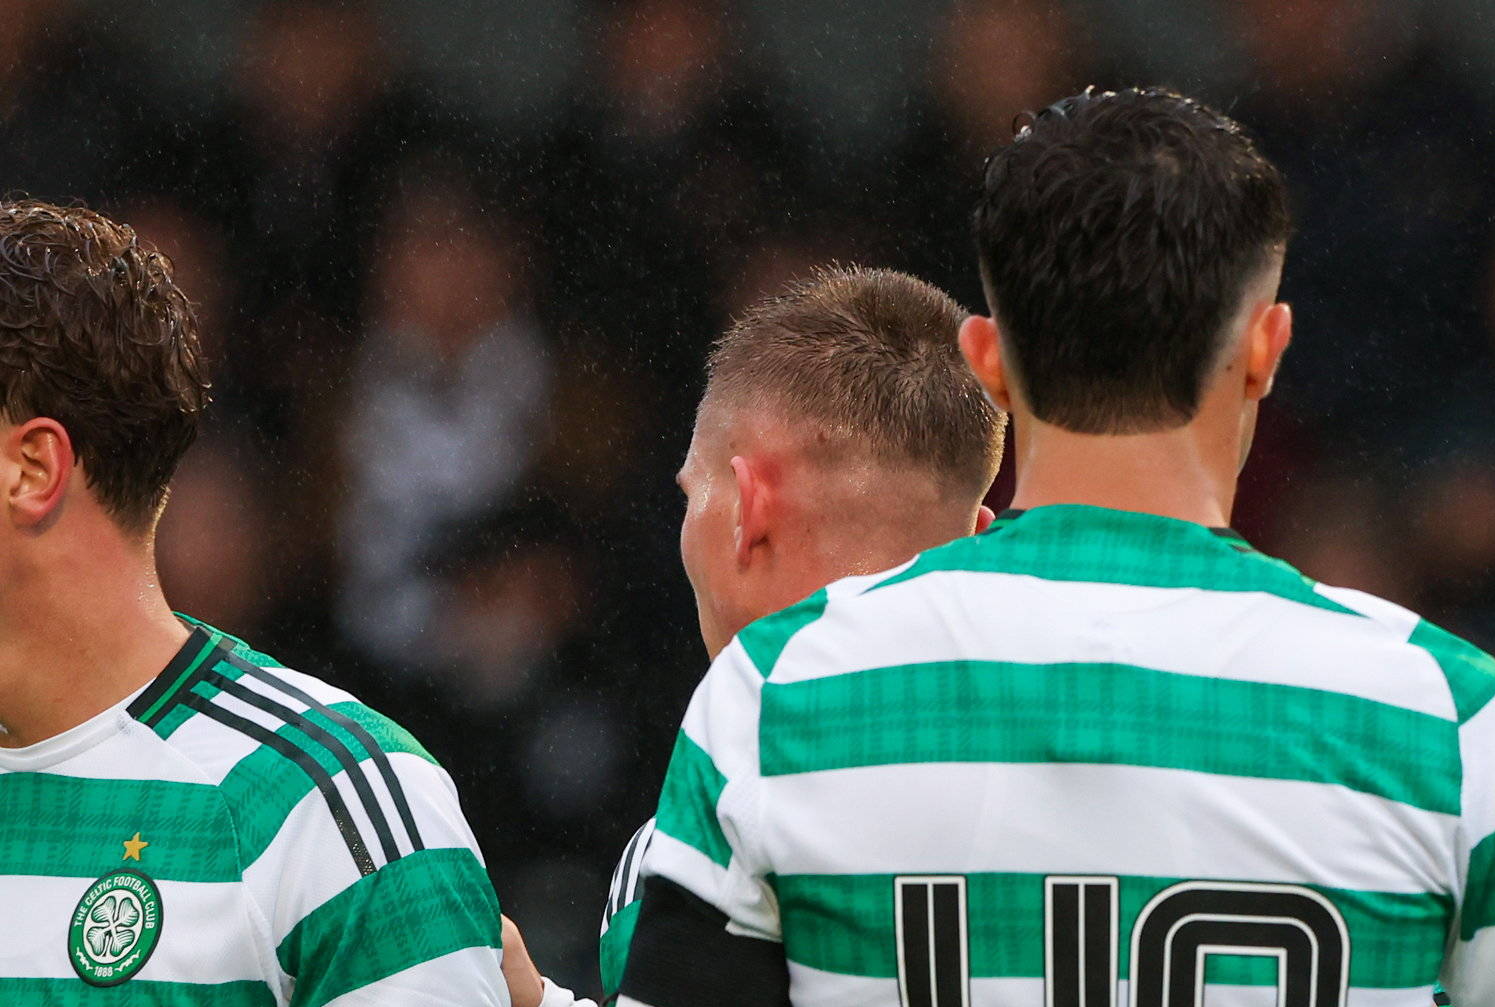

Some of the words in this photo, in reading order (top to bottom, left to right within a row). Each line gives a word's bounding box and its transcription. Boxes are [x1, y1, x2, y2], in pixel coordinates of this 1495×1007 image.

[74, 906, 89, 927] THE
[86, 879, 113, 906] CELTIC
[113, 876, 152, 903] FOOTBALL
[144, 900, 157, 929] CLUB
